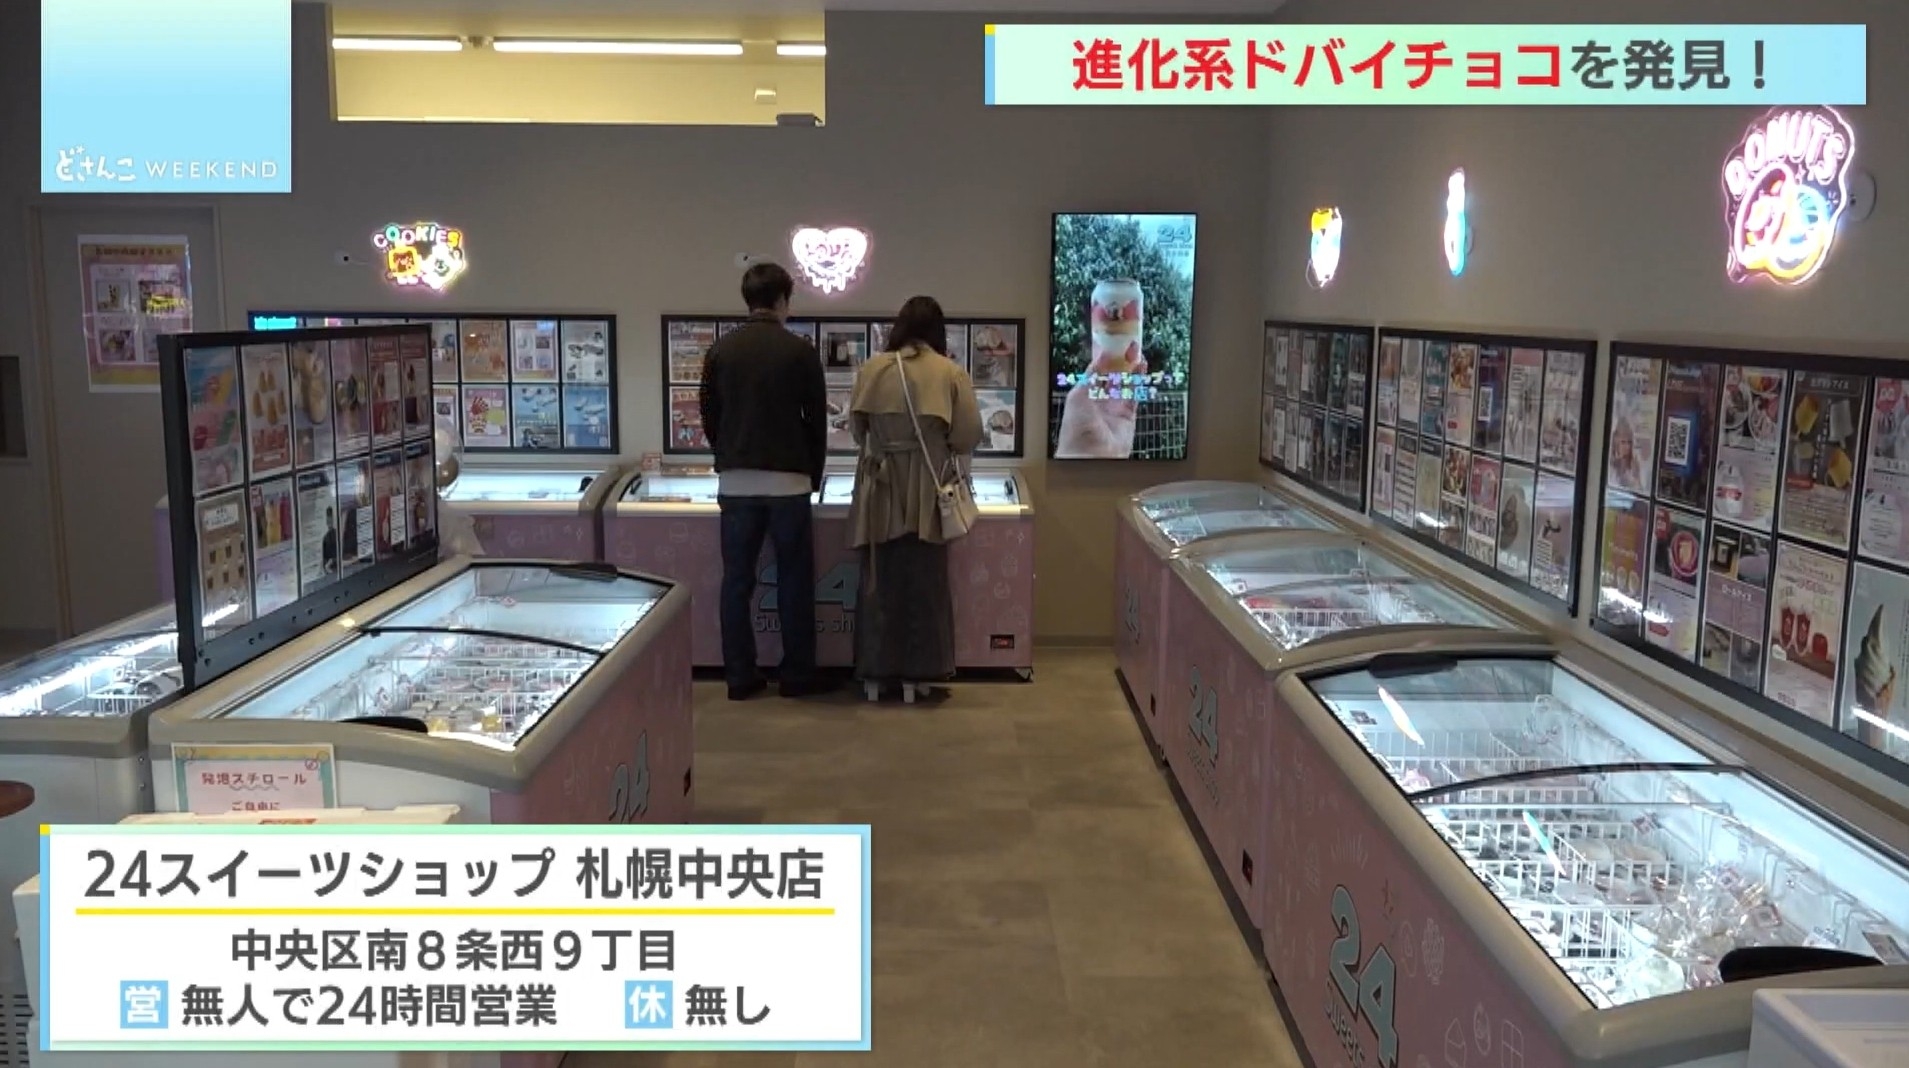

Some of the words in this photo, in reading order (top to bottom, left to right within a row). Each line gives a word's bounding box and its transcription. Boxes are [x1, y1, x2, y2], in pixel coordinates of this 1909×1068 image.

[1725, 111, 1845, 200] DONUTS
[373, 225, 460, 249] COOKIES
[1189, 665, 1219, 768] 24
[201, 772, 307, 786] 発泡スチロール
[1329, 884, 1399, 1068] 24
